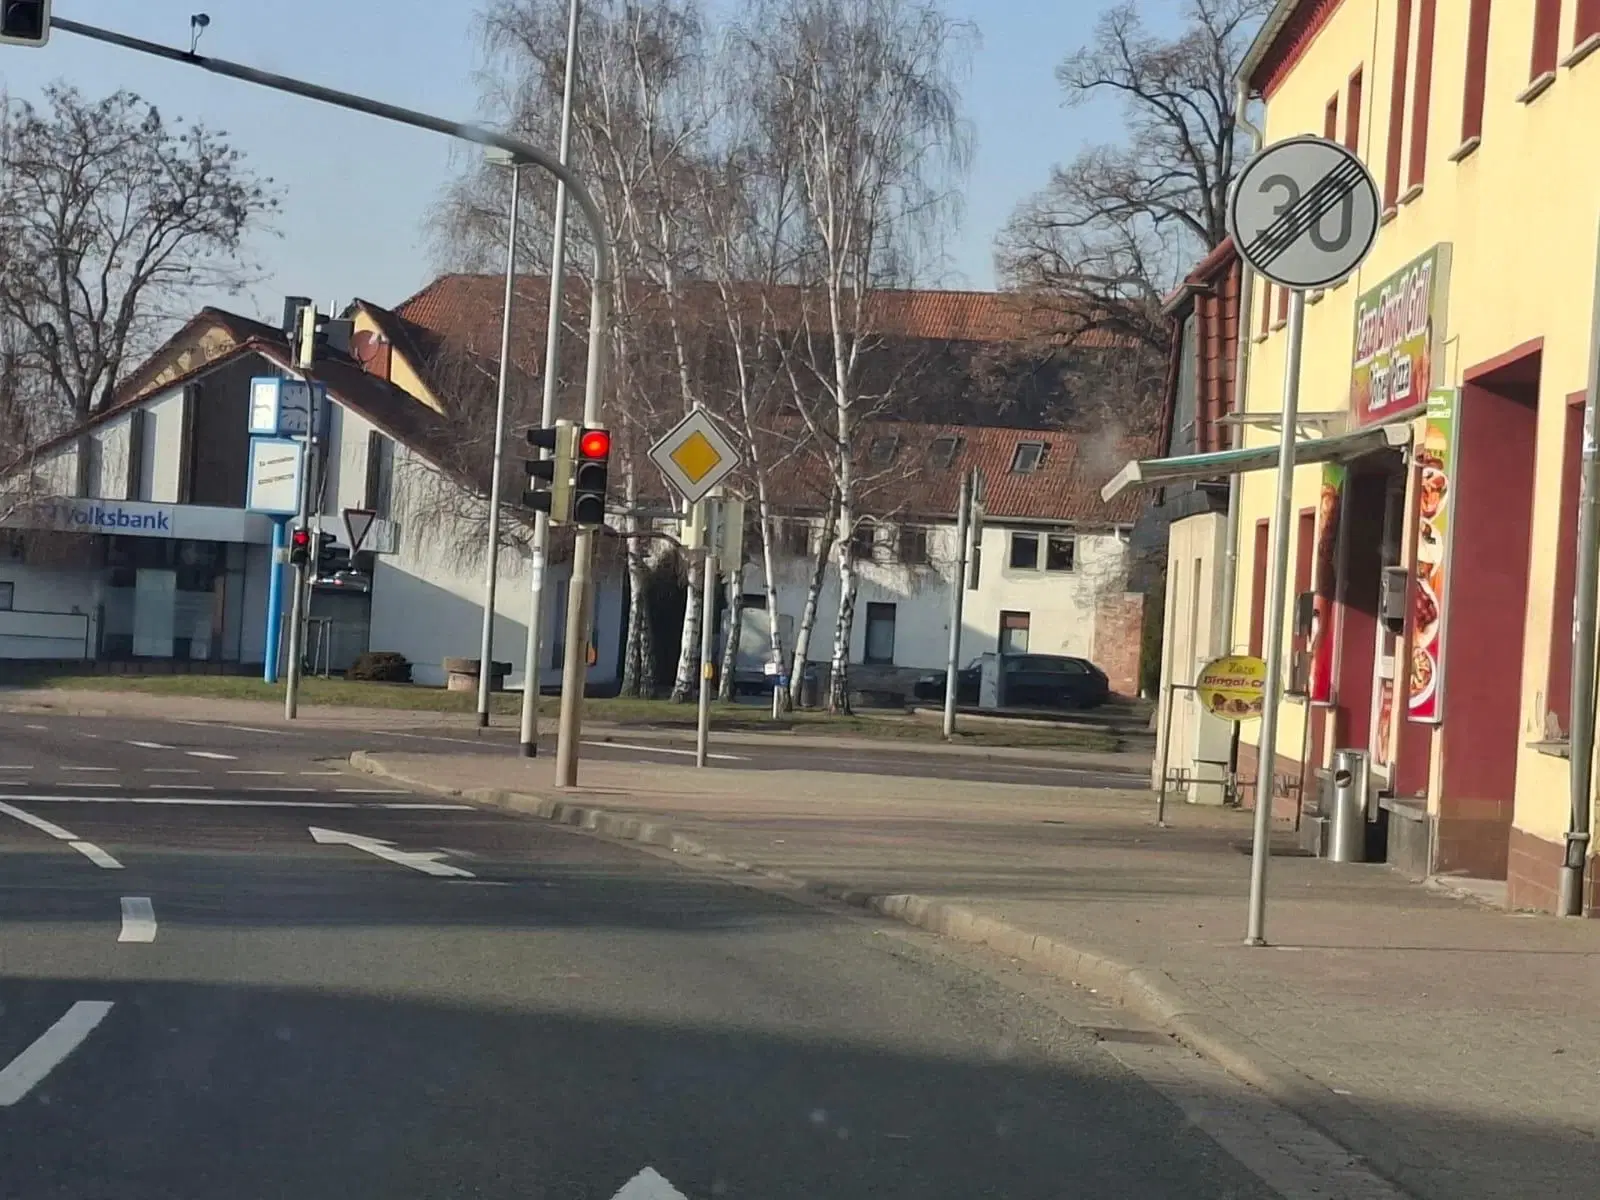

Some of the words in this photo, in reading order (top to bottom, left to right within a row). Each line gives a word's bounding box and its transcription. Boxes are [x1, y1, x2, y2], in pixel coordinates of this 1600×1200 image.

[1256, 173, 1353, 252] 30
[1390, 353, 1411, 401] Pizza
[65, 506, 169, 531] Volksbank
